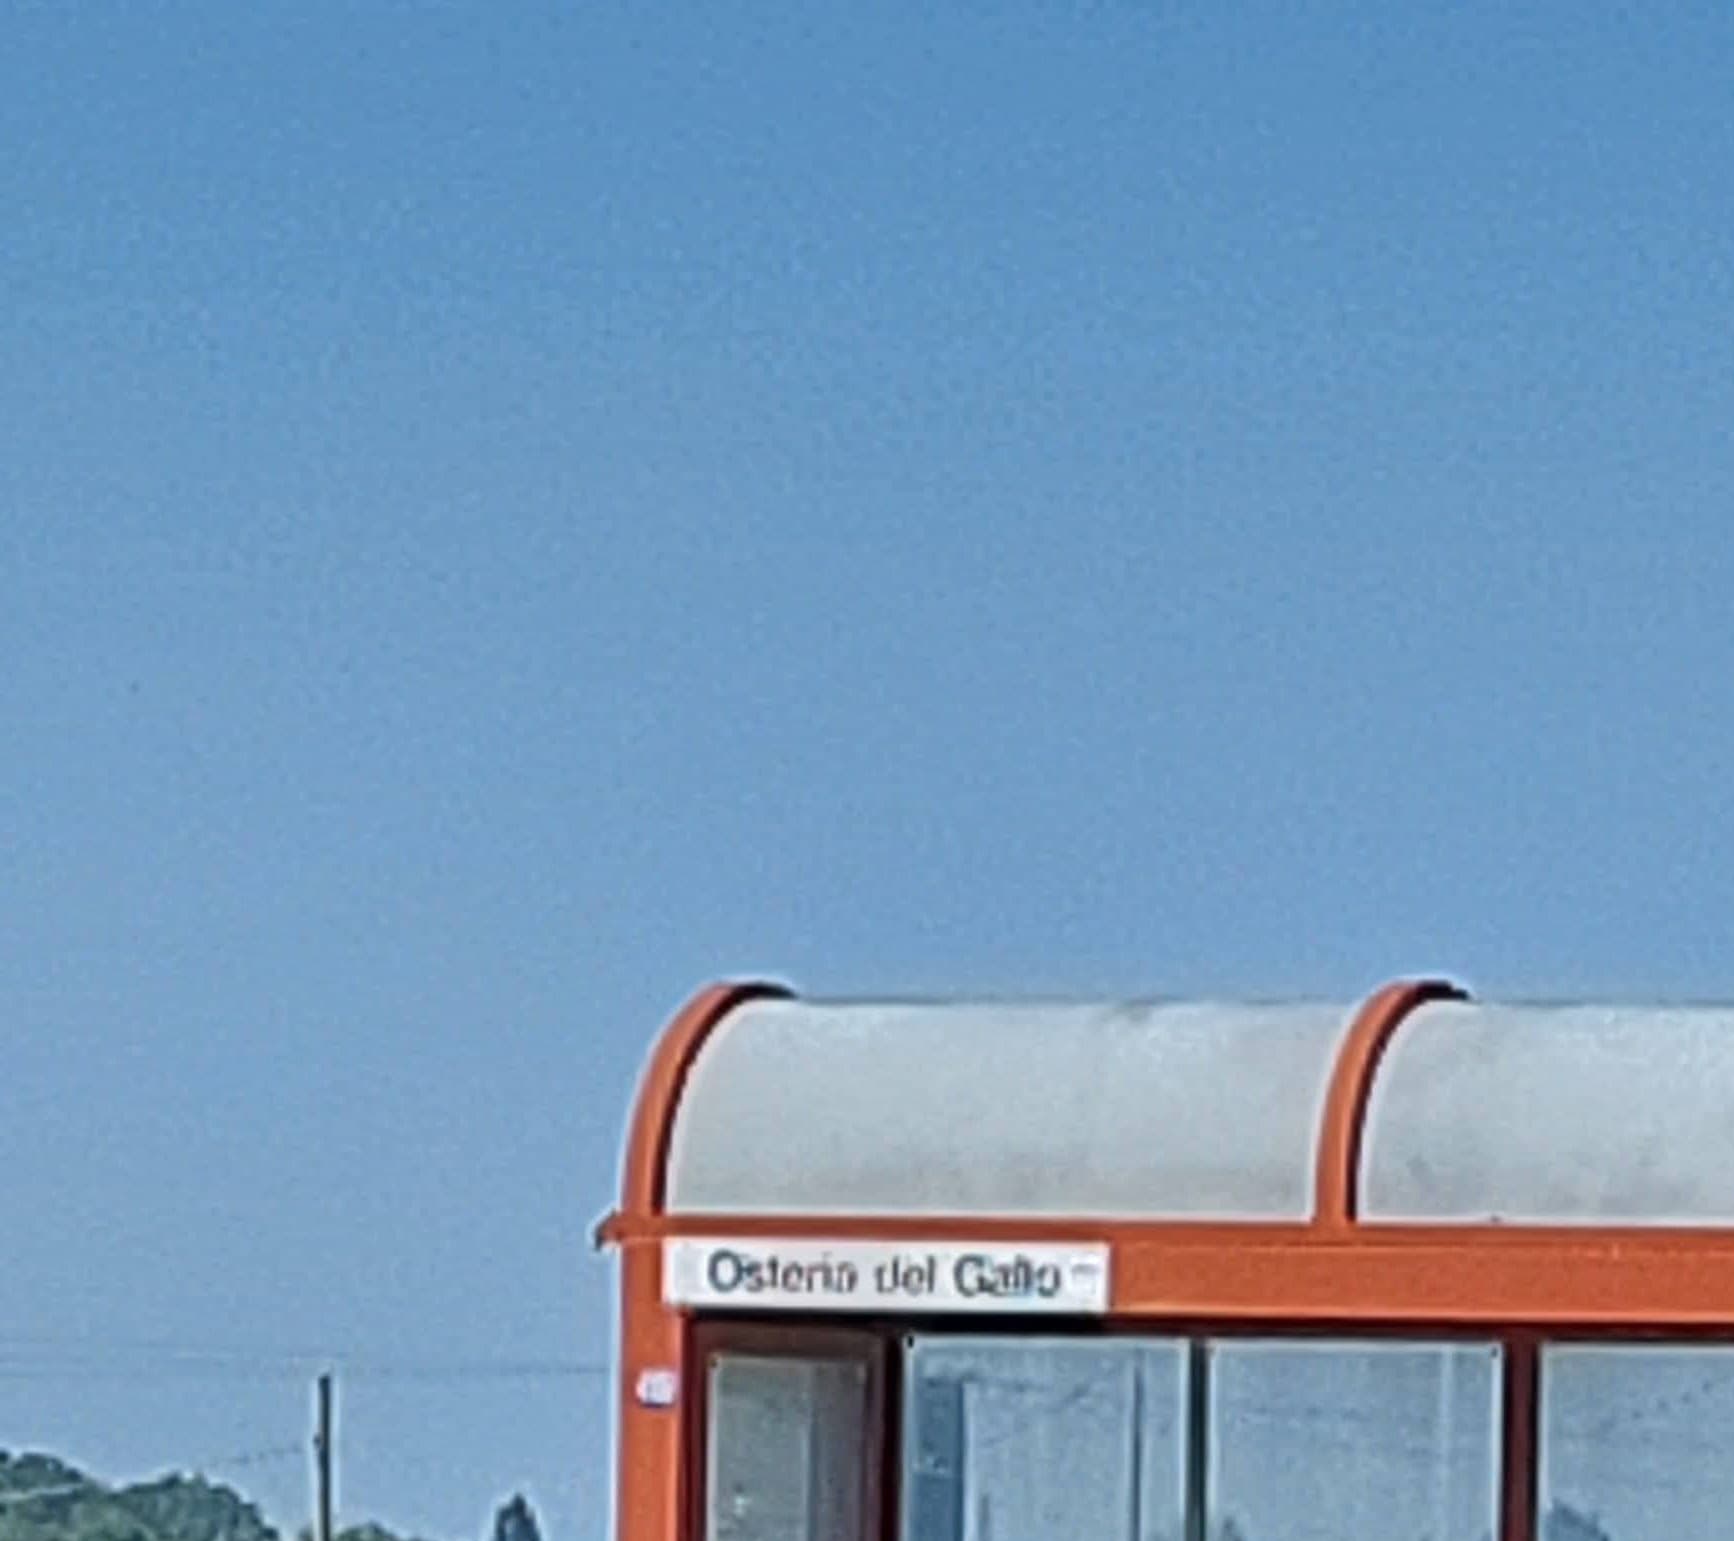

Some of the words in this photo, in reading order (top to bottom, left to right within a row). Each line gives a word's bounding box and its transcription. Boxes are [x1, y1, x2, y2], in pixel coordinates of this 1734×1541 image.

[707, 1249, 858, 1293] Osteria
[874, 1253, 936, 1296] del
[953, 1253, 1063, 1298] Gallo
